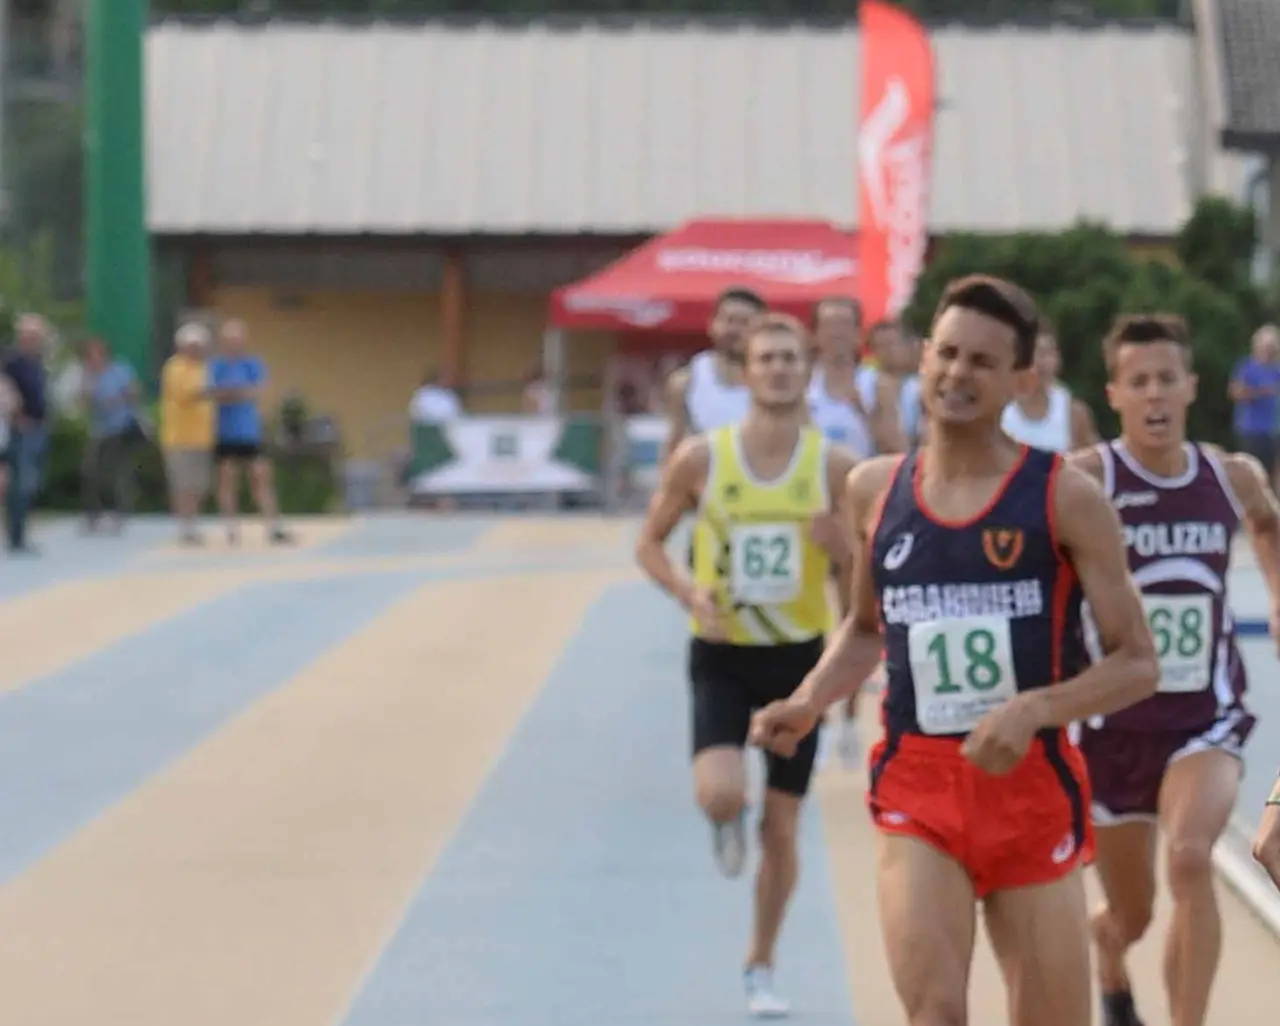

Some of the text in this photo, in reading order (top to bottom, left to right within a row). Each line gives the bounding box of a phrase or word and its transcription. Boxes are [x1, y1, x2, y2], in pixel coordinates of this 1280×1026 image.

[742, 536, 790, 580] 62
[1122, 522, 1227, 556] POLIZIA
[1150, 607, 1203, 657] 68
[926, 628, 1003, 694] 18
